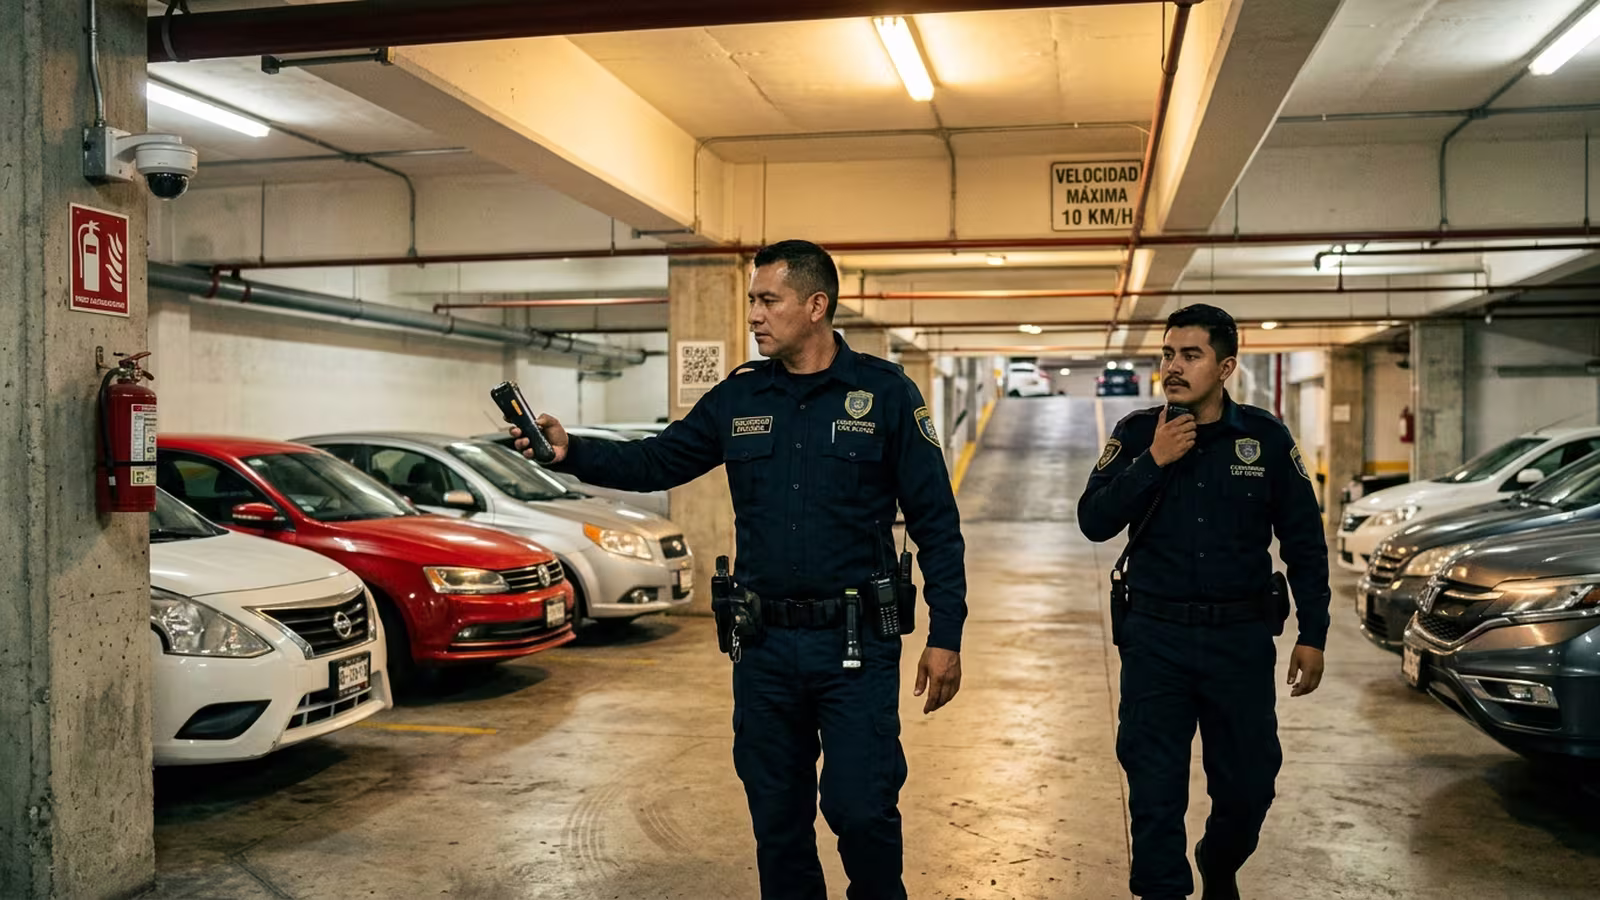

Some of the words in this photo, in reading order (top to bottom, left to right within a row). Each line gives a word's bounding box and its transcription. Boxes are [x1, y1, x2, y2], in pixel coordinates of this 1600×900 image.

[1055, 166, 1138, 184] VELOCIDAD
[1066, 185, 1128, 204] MÁXIMA
[1061, 208, 1082, 226] 10
[1088, 207, 1133, 226] KM/H
